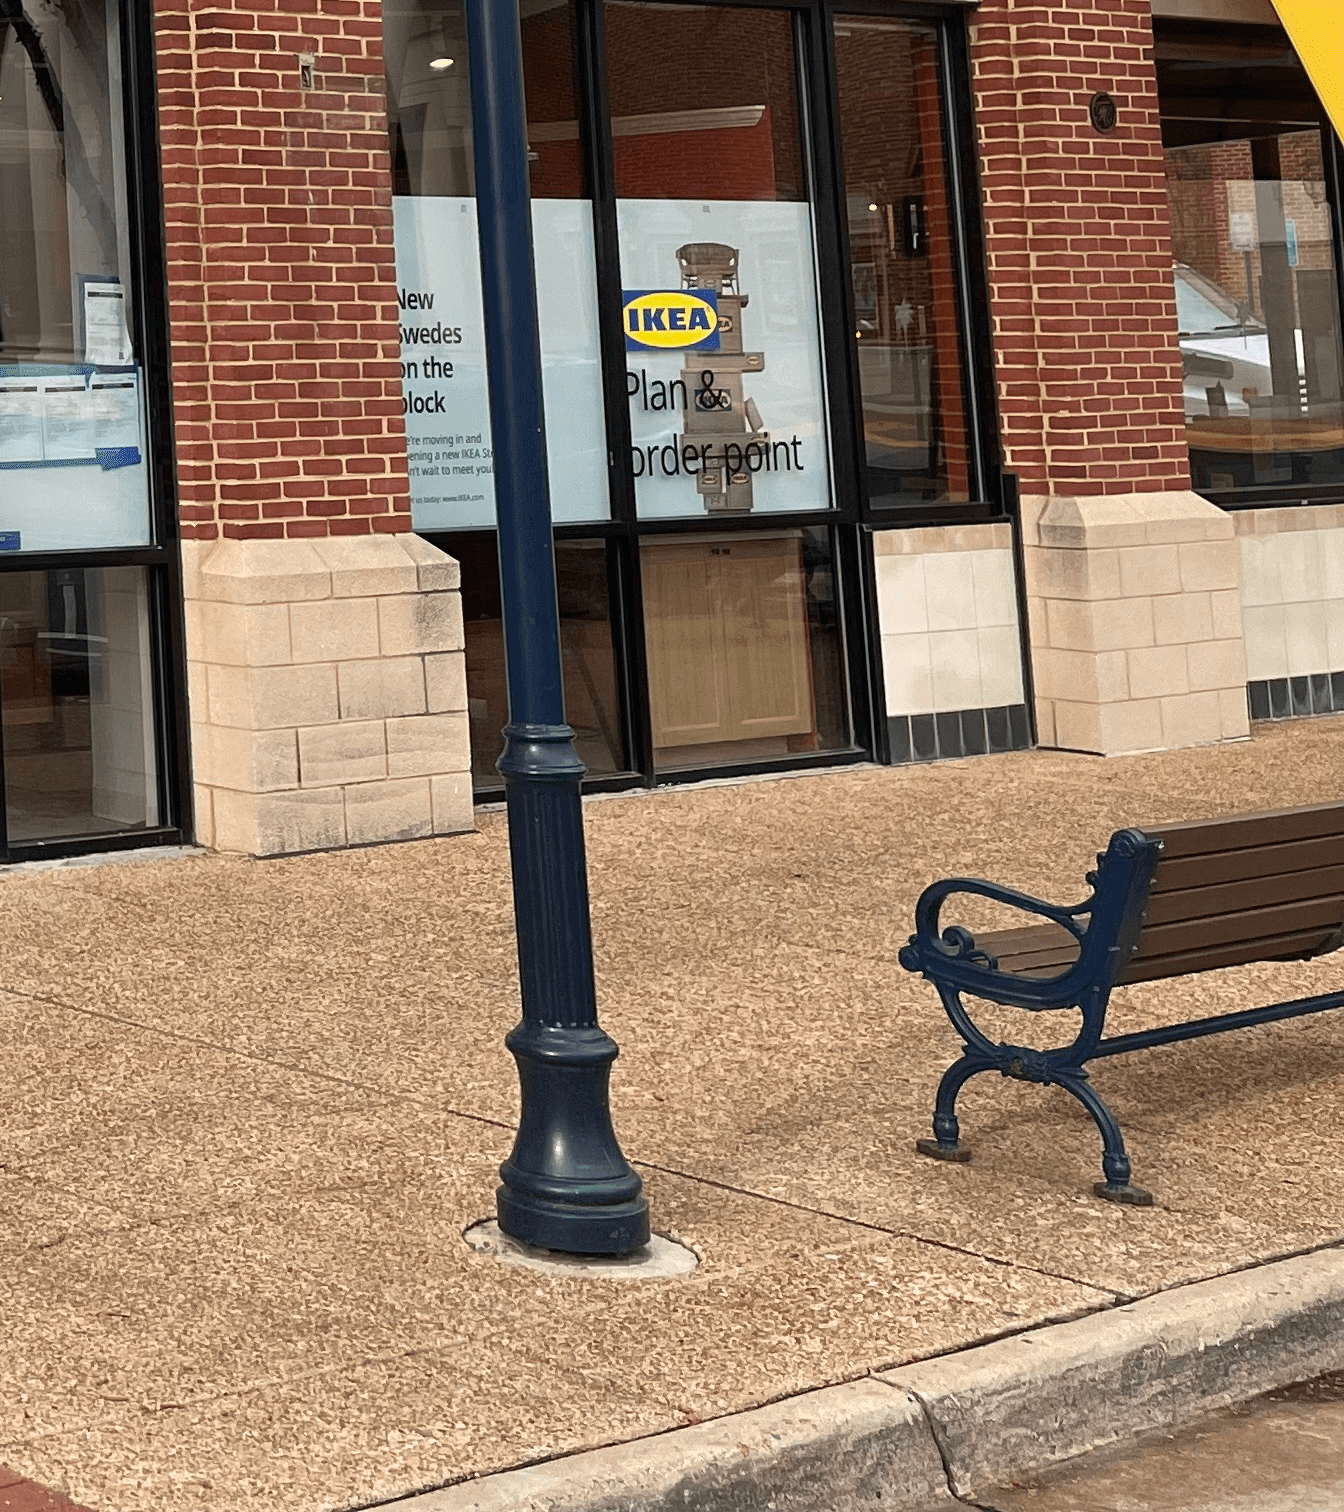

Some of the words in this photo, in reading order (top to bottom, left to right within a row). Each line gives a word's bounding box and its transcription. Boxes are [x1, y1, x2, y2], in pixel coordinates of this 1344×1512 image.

[629, 307, 711, 331] IKEA
[423, 356, 454, 379] the
[700, 369, 725, 409] &
[422, 433, 453, 447] moving
[455, 433, 464, 444] in
[466, 433, 482, 444] and
[442, 451, 460, 460] new
[461, 448, 480, 459] IKEA
[631, 433, 712, 478] order
[724, 432, 804, 486] point
[422, 465, 439, 476] wait
[441, 466, 450, 476] to
[453, 465, 474, 475] meet
